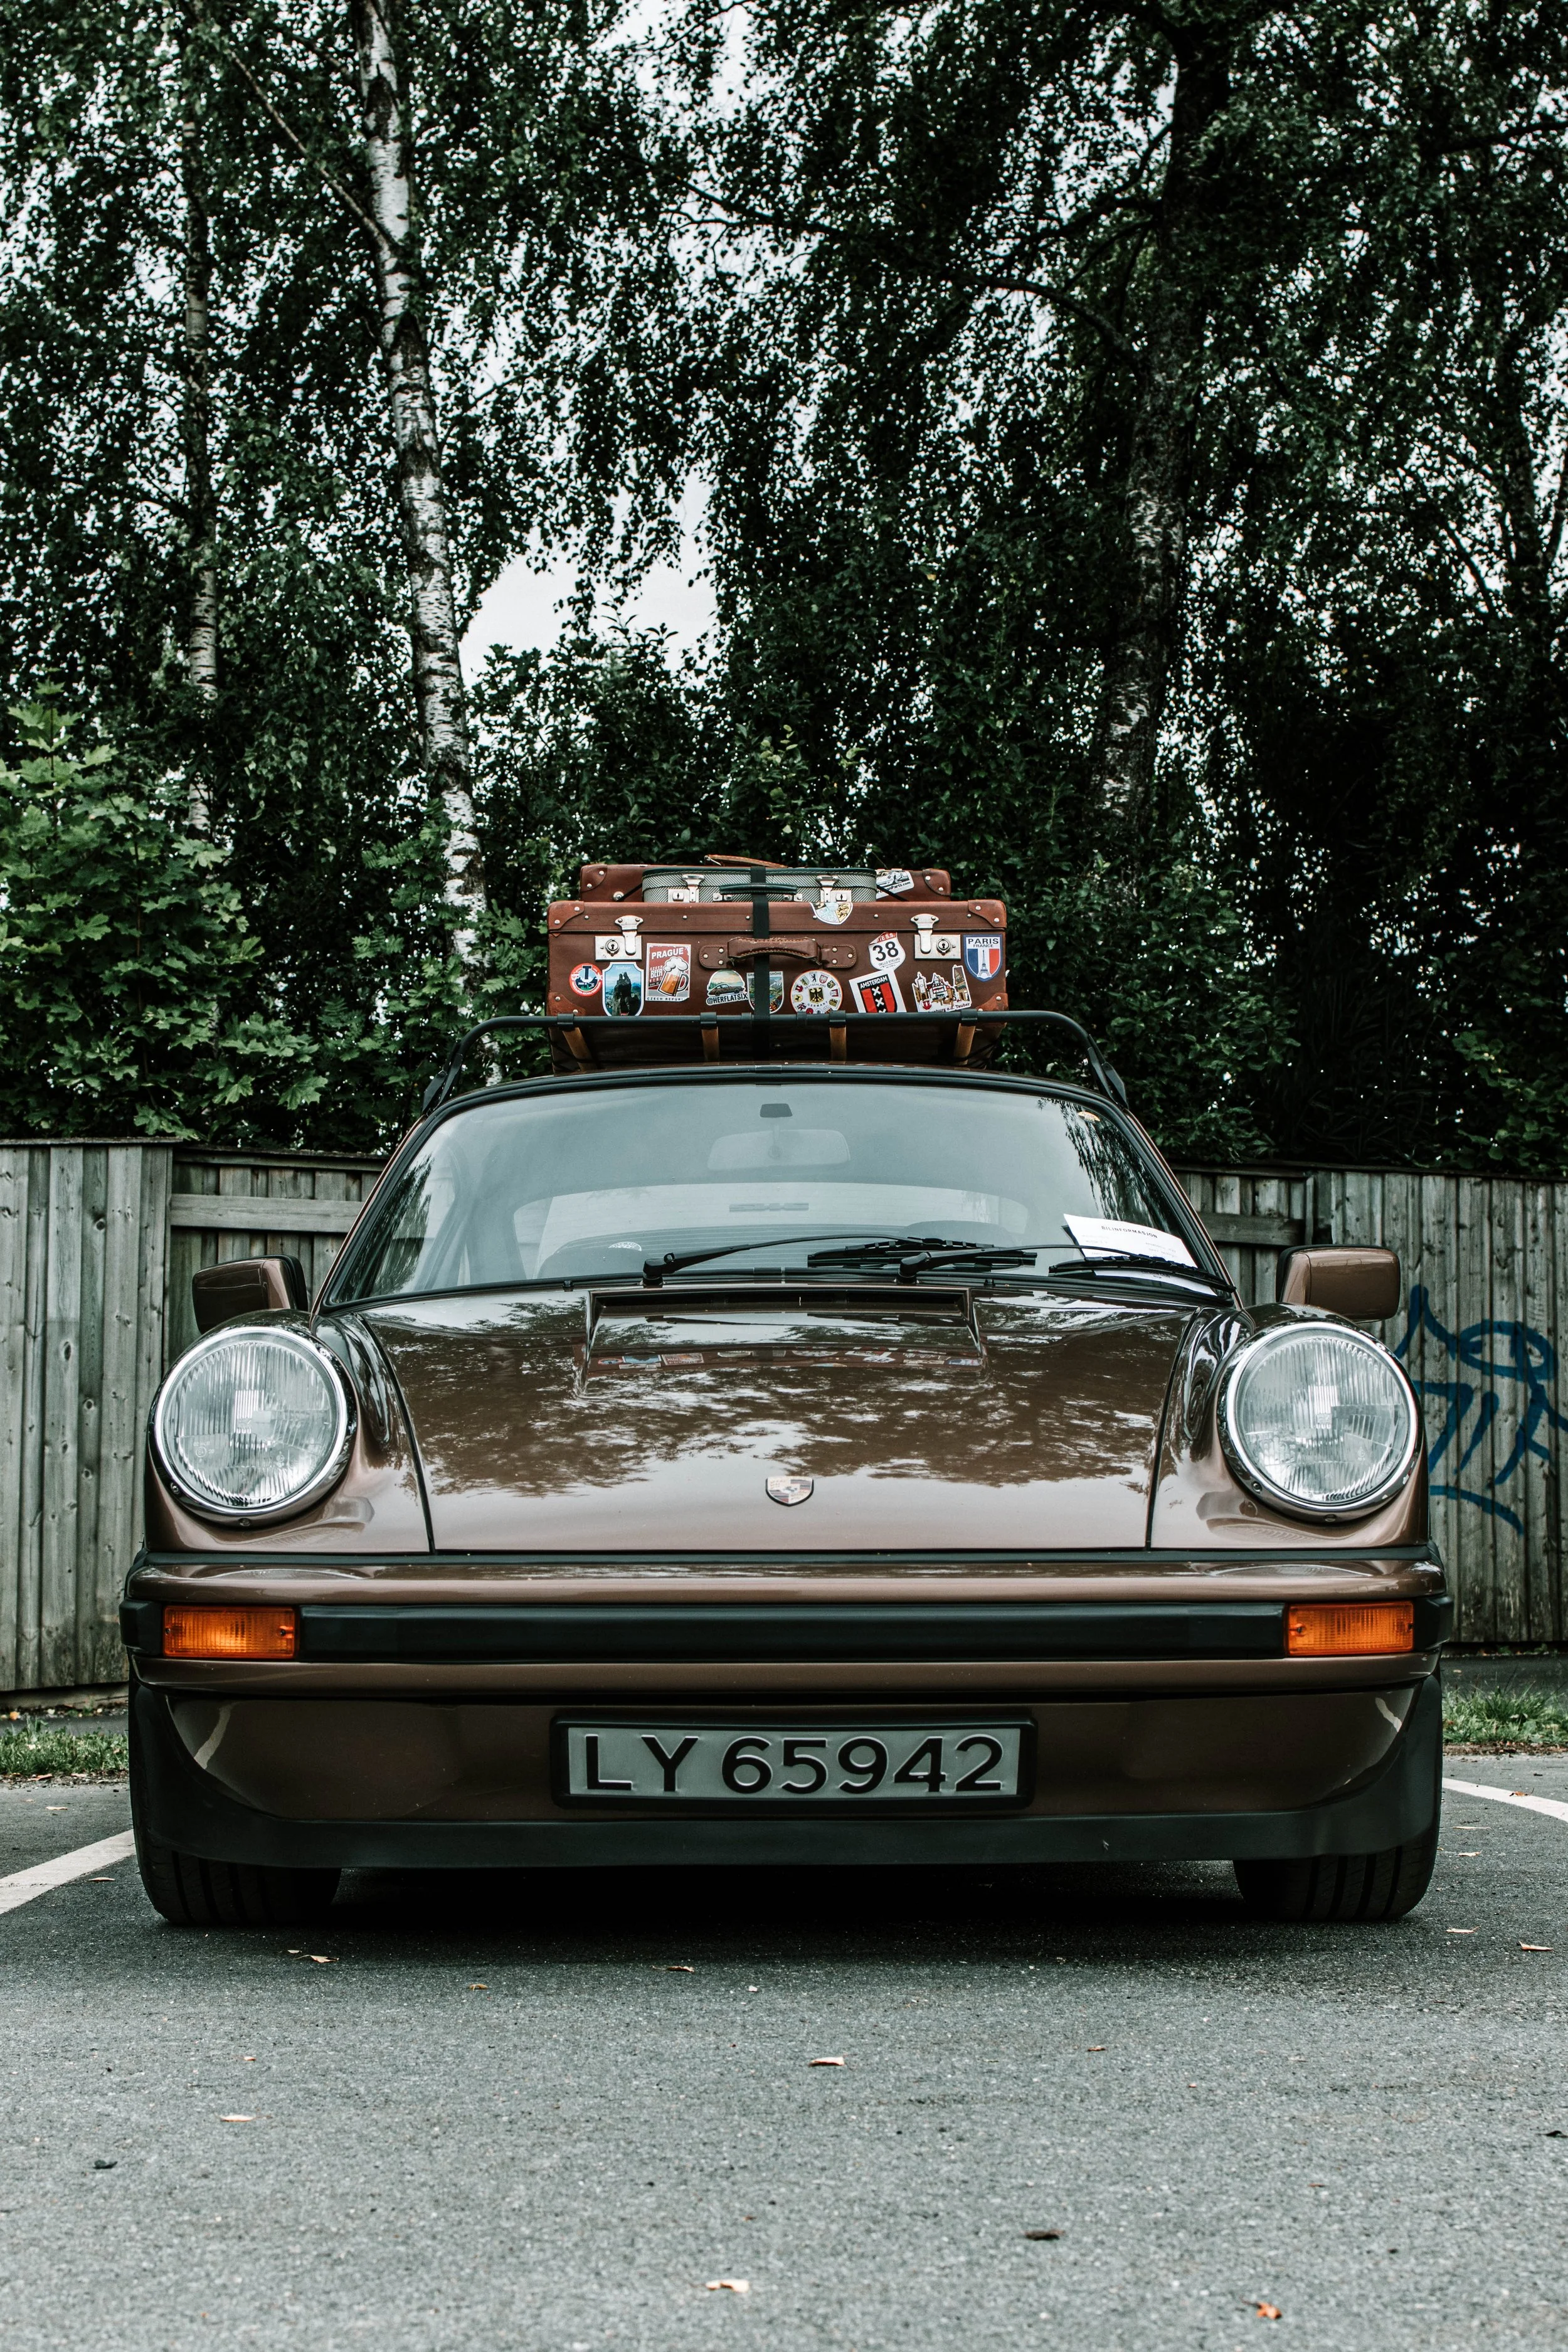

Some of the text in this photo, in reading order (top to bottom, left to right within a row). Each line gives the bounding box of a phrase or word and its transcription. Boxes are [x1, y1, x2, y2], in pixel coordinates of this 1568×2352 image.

[652, 947, 684, 960] PRAGUE
[872, 941, 899, 961] 38
[582, 965, 592, 980] T
[650, 968, 663, 978] BEER
[860, 975, 888, 989] AMSTERDAM
[707, 993, 748, 1004] @HERFLATSIX
[1101, 1226, 1158, 1238] BILINFORMASJON
[585, 1734, 1004, 1794] LY 65942
